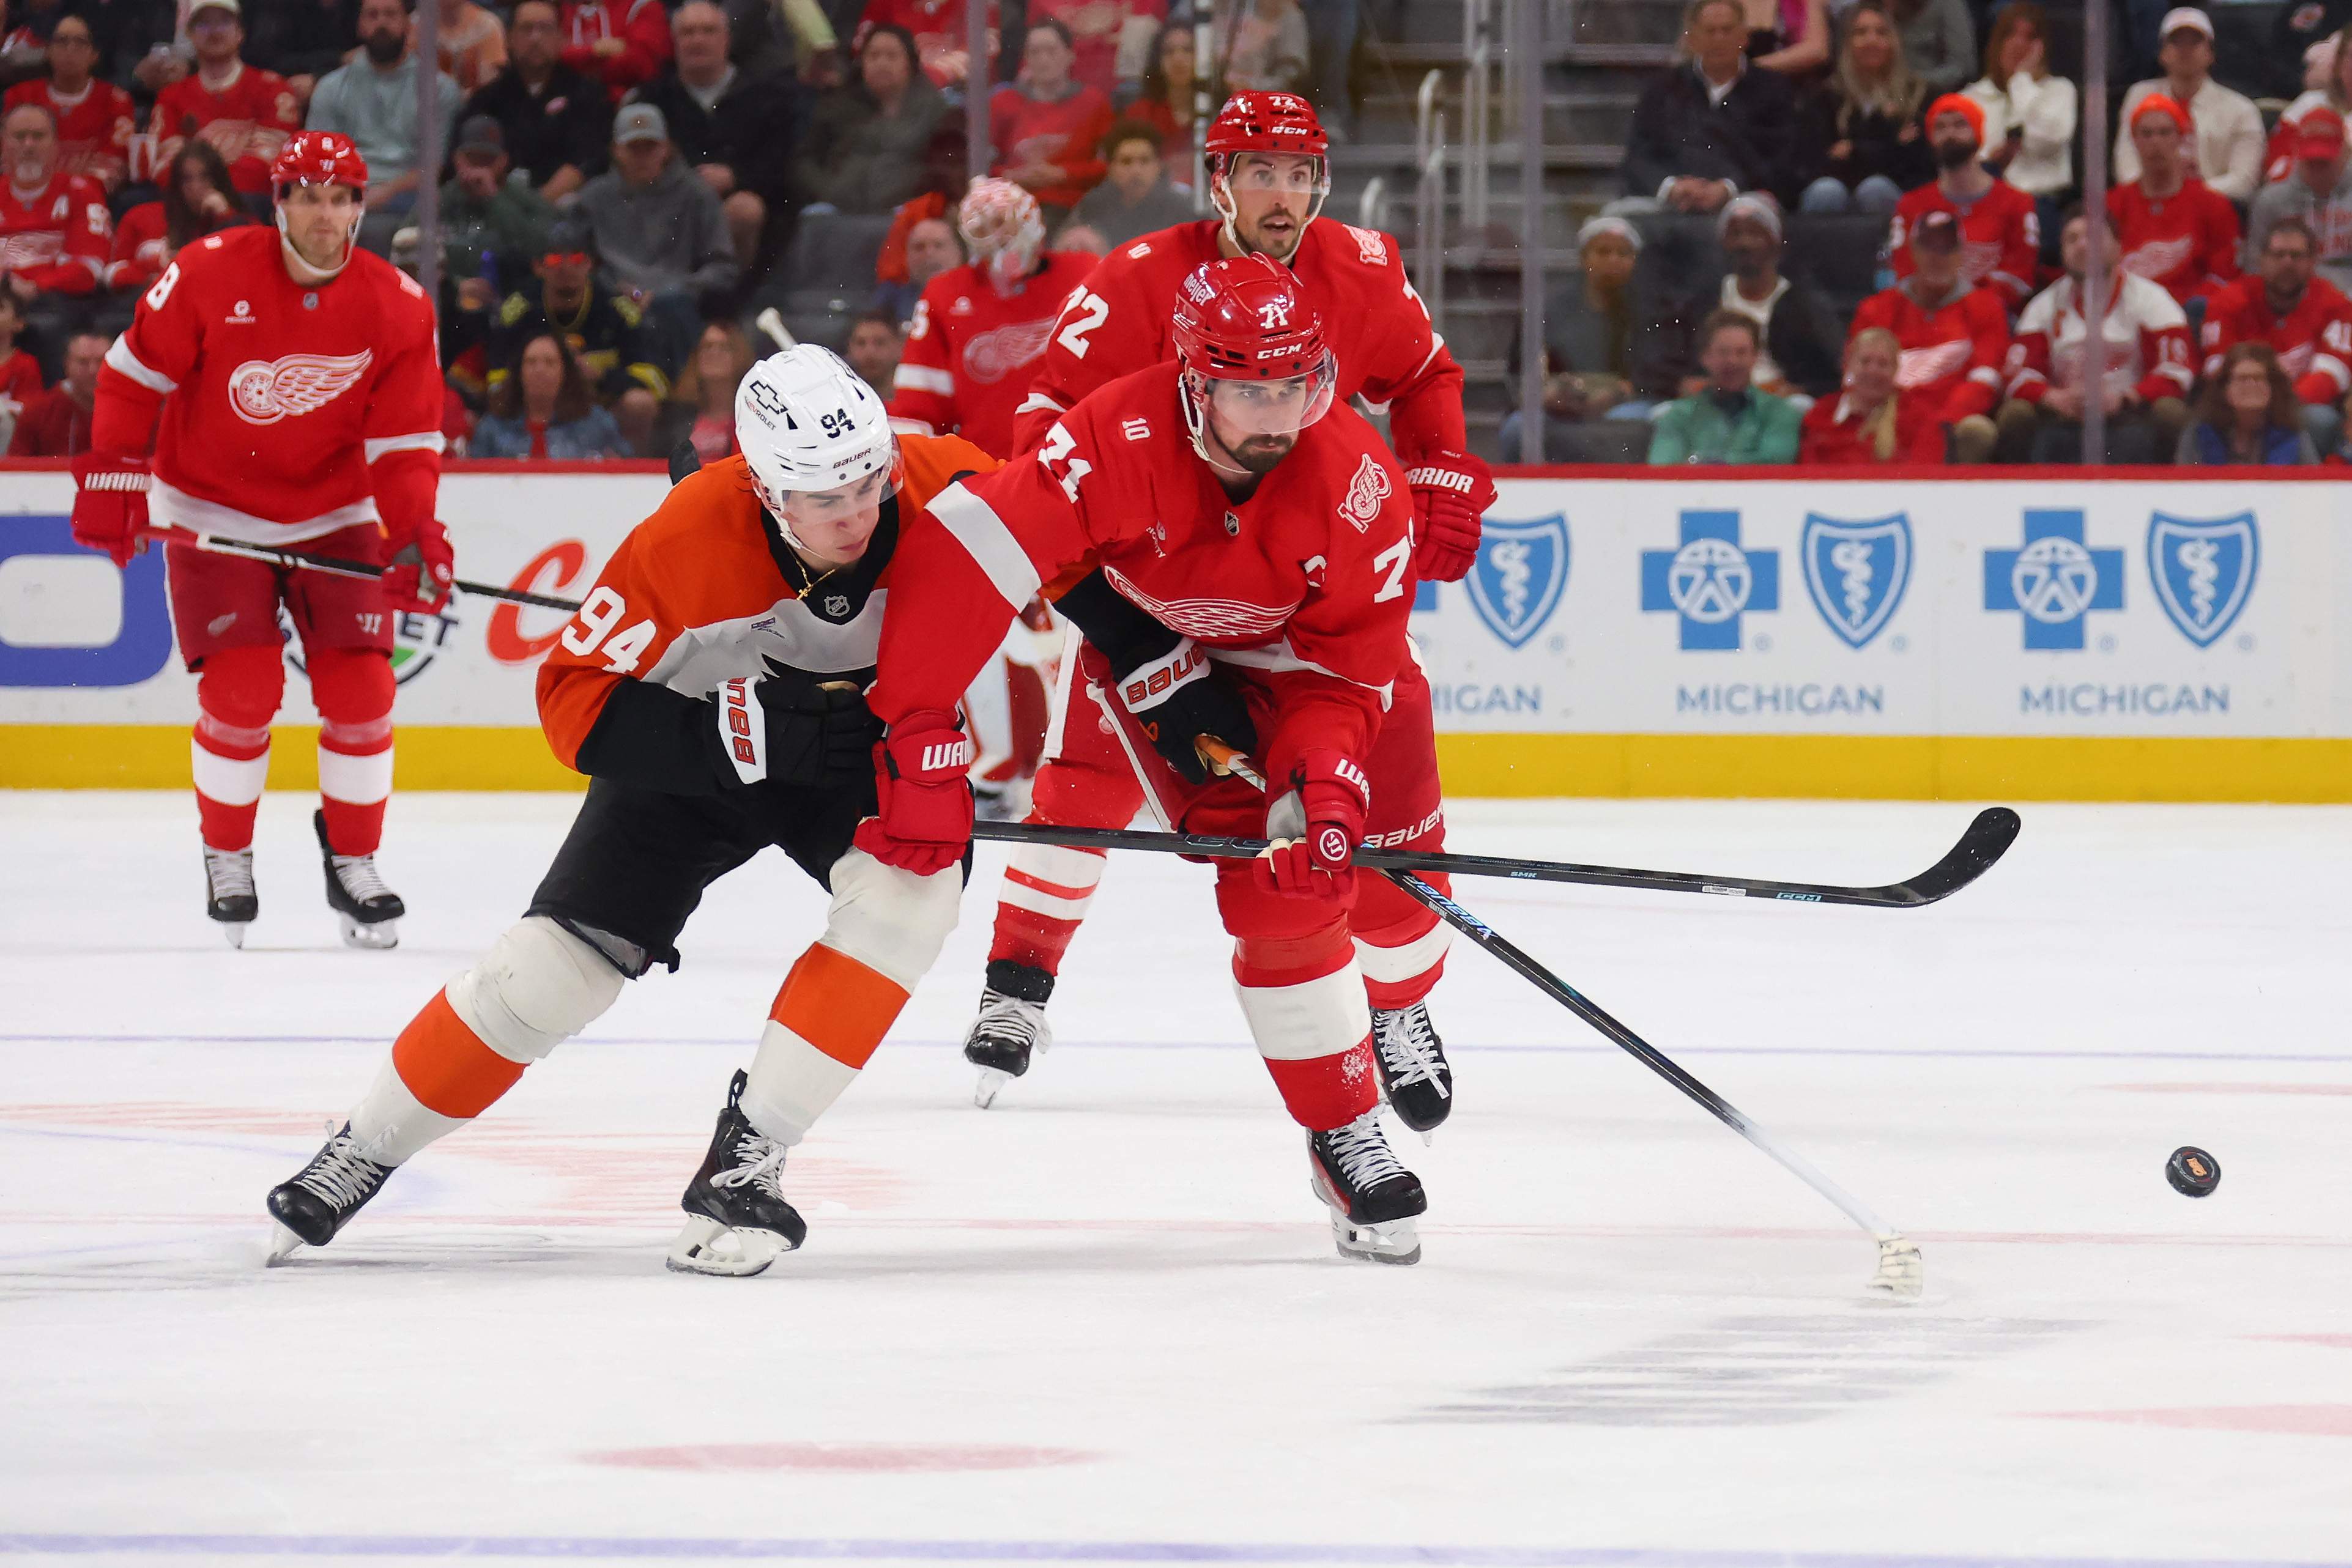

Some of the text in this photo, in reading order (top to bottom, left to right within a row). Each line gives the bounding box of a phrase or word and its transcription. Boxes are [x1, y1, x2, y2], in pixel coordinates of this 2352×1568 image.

[146, 261, 180, 309] 8
[1257, 343, 1302, 360] CCM
[820, 408, 855, 439] 94
[1121, 413, 1151, 441] 10
[1405, 467, 1474, 494] RRIOR
[562, 586, 658, 674] 94
[1431, 684, 1543, 715] IGAN
[1676, 683, 1883, 715] MICHIGAN
[2019, 683, 2230, 716] MICHIGAN
[1776, 891, 1823, 903] CCM
